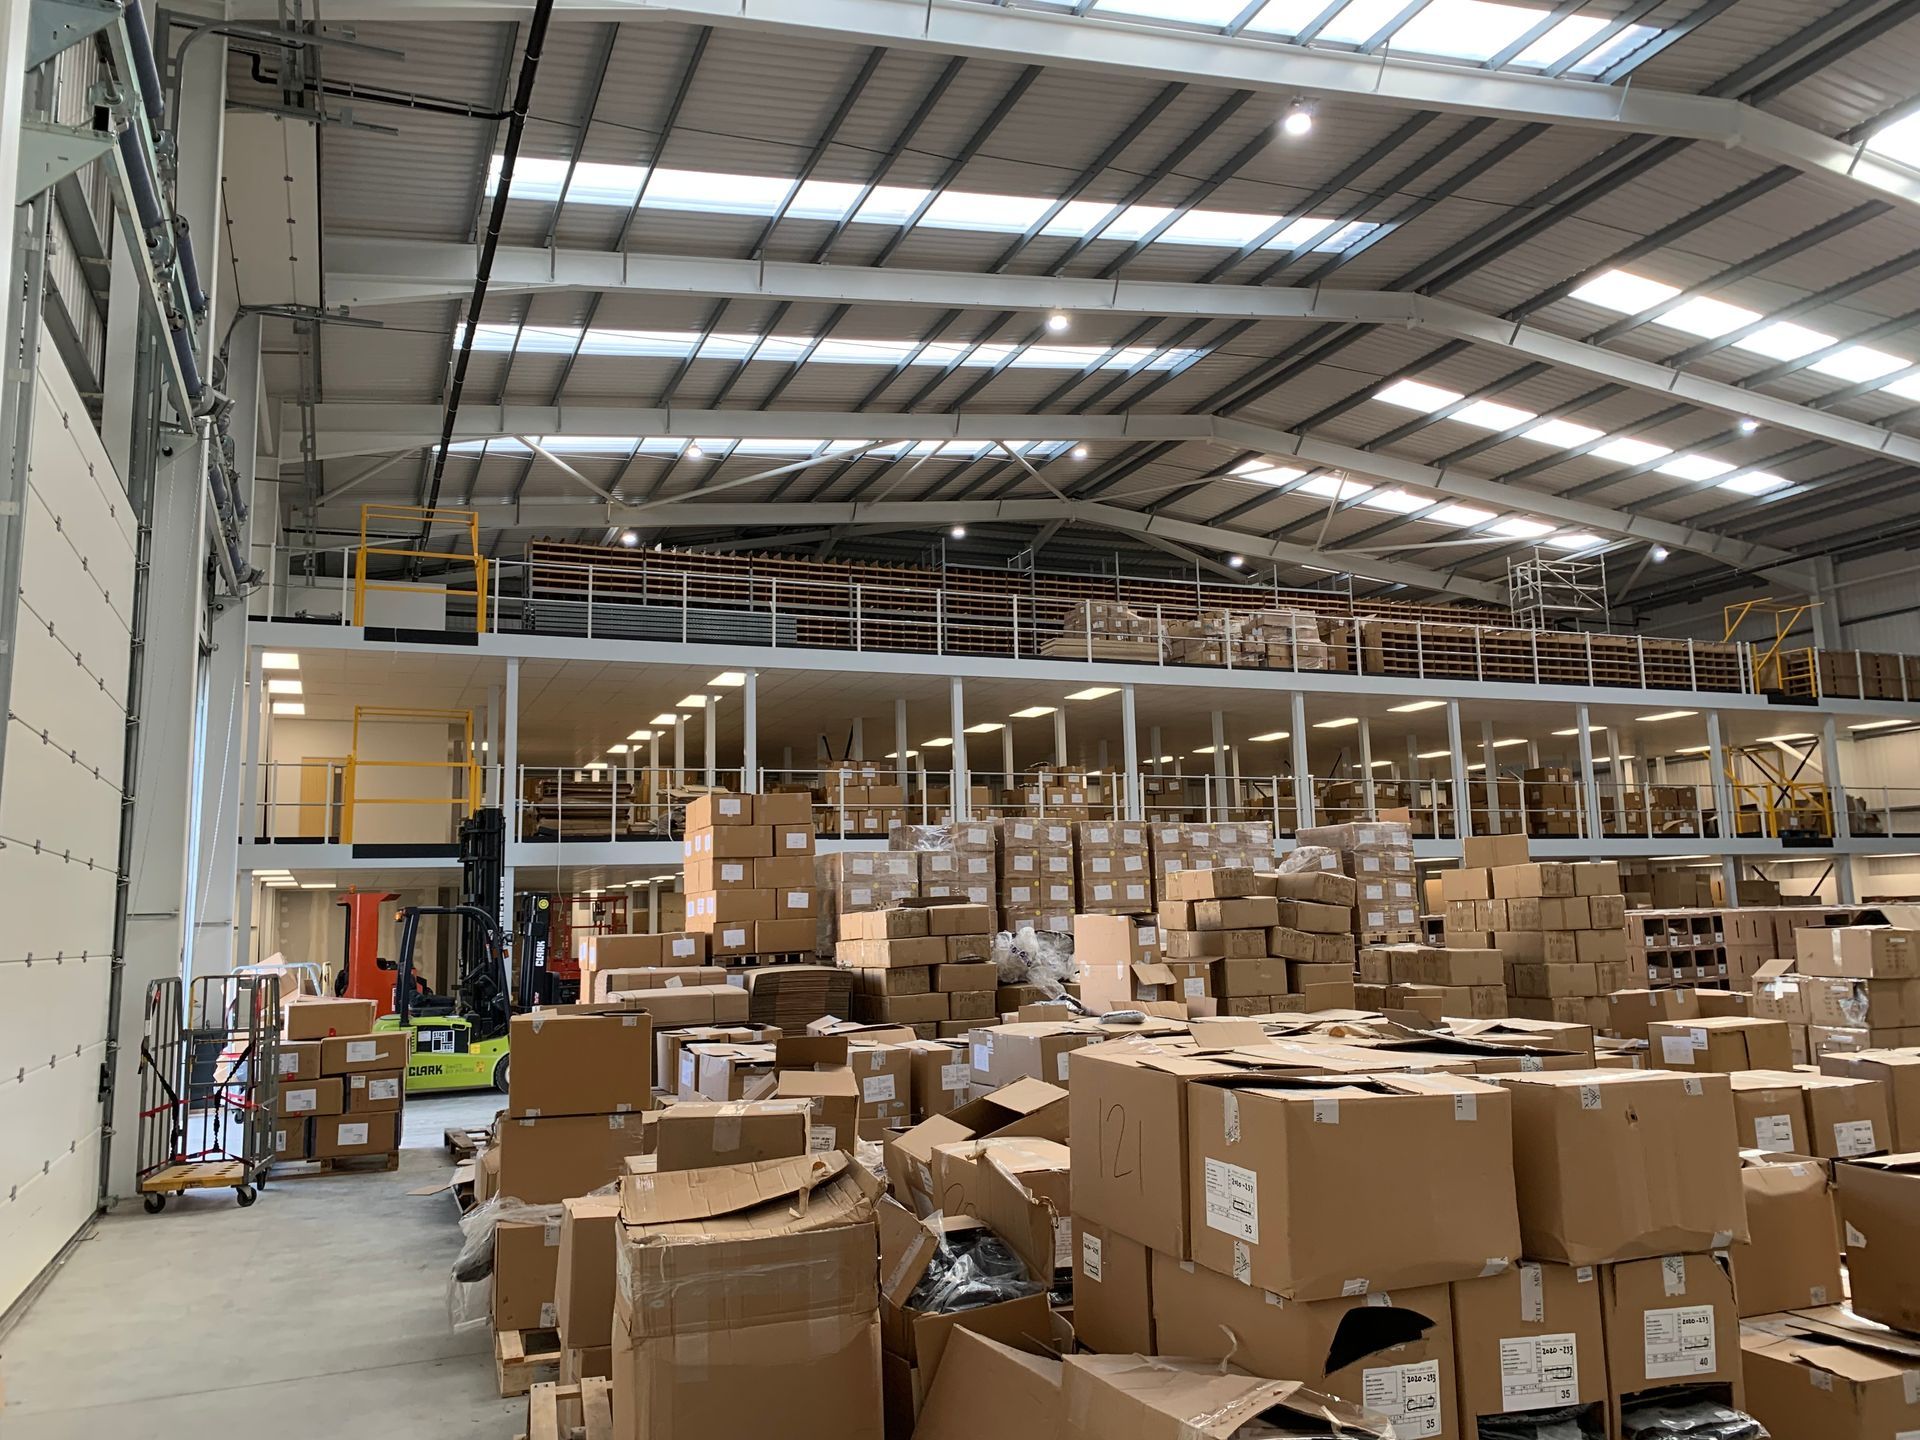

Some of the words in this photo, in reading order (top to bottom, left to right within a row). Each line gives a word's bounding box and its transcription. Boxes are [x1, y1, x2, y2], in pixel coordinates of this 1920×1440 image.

[535, 940, 545, 967] CLARK
[408, 1065, 443, 1077] CLARK
[1099, 1096, 1145, 1197] 121
[1244, 1223, 1252, 1234] 35
[1542, 1345, 1573, 1356] 2020-233
[1699, 1357, 1709, 1366] 40
[1561, 1389, 1570, 1399] 35
[1426, 1418, 1435, 1429] 35
